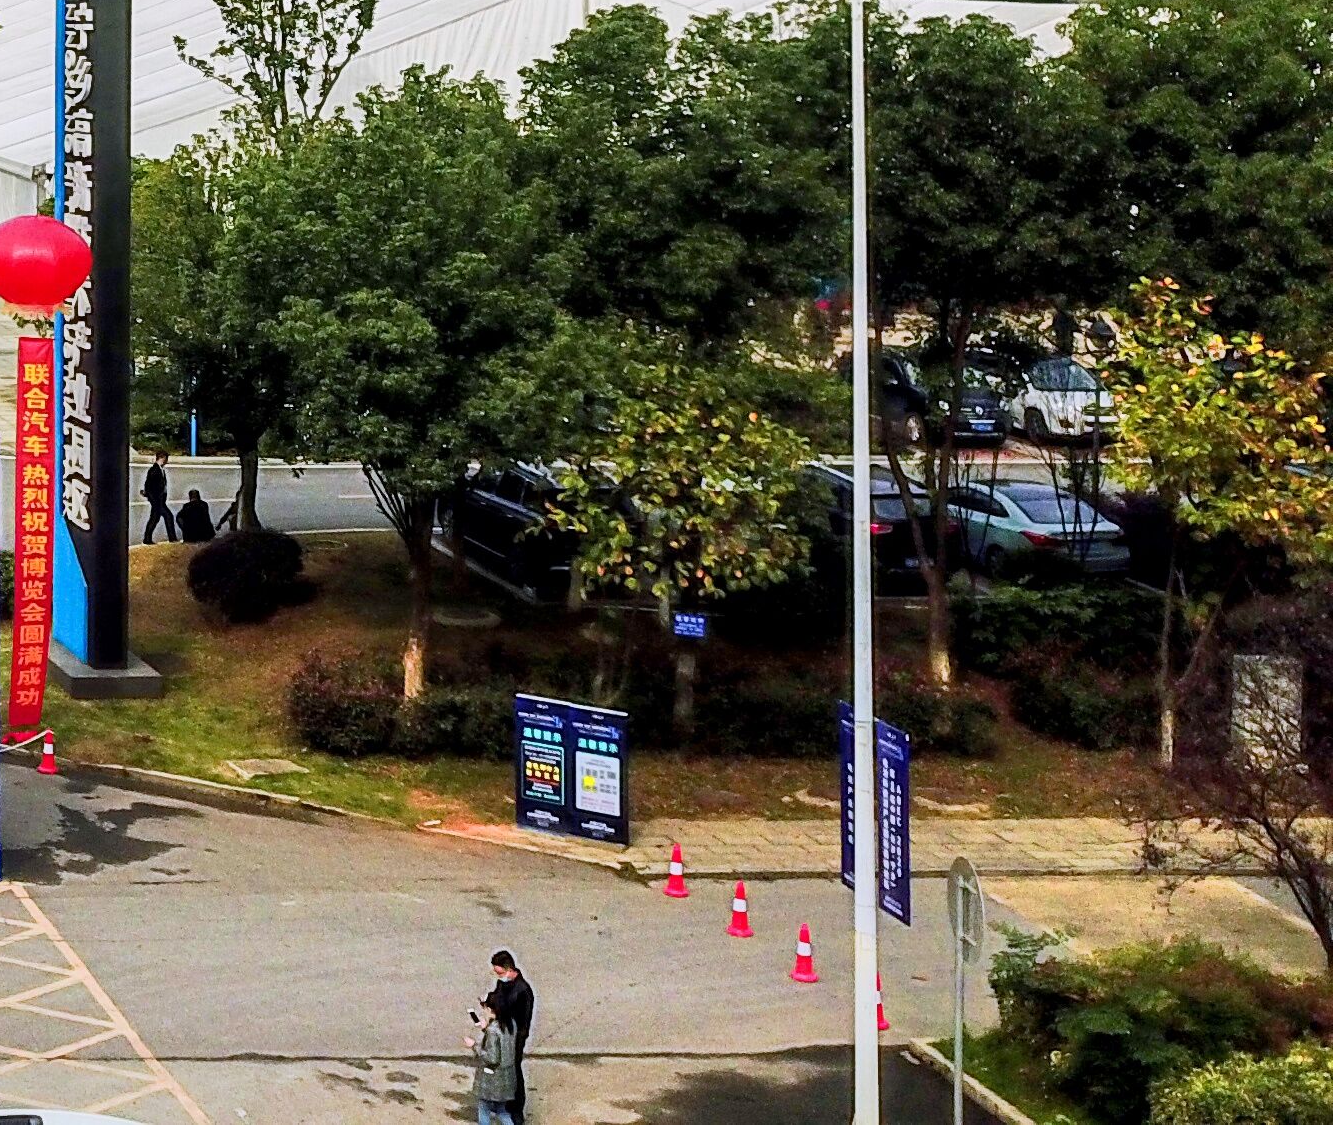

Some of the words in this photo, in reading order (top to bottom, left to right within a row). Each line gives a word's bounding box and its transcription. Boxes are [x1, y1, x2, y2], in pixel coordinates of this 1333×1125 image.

[22, 362, 51, 458] 联合汽车
[16, 462, 51, 708] 热烈祝贺博览会圆满成功
